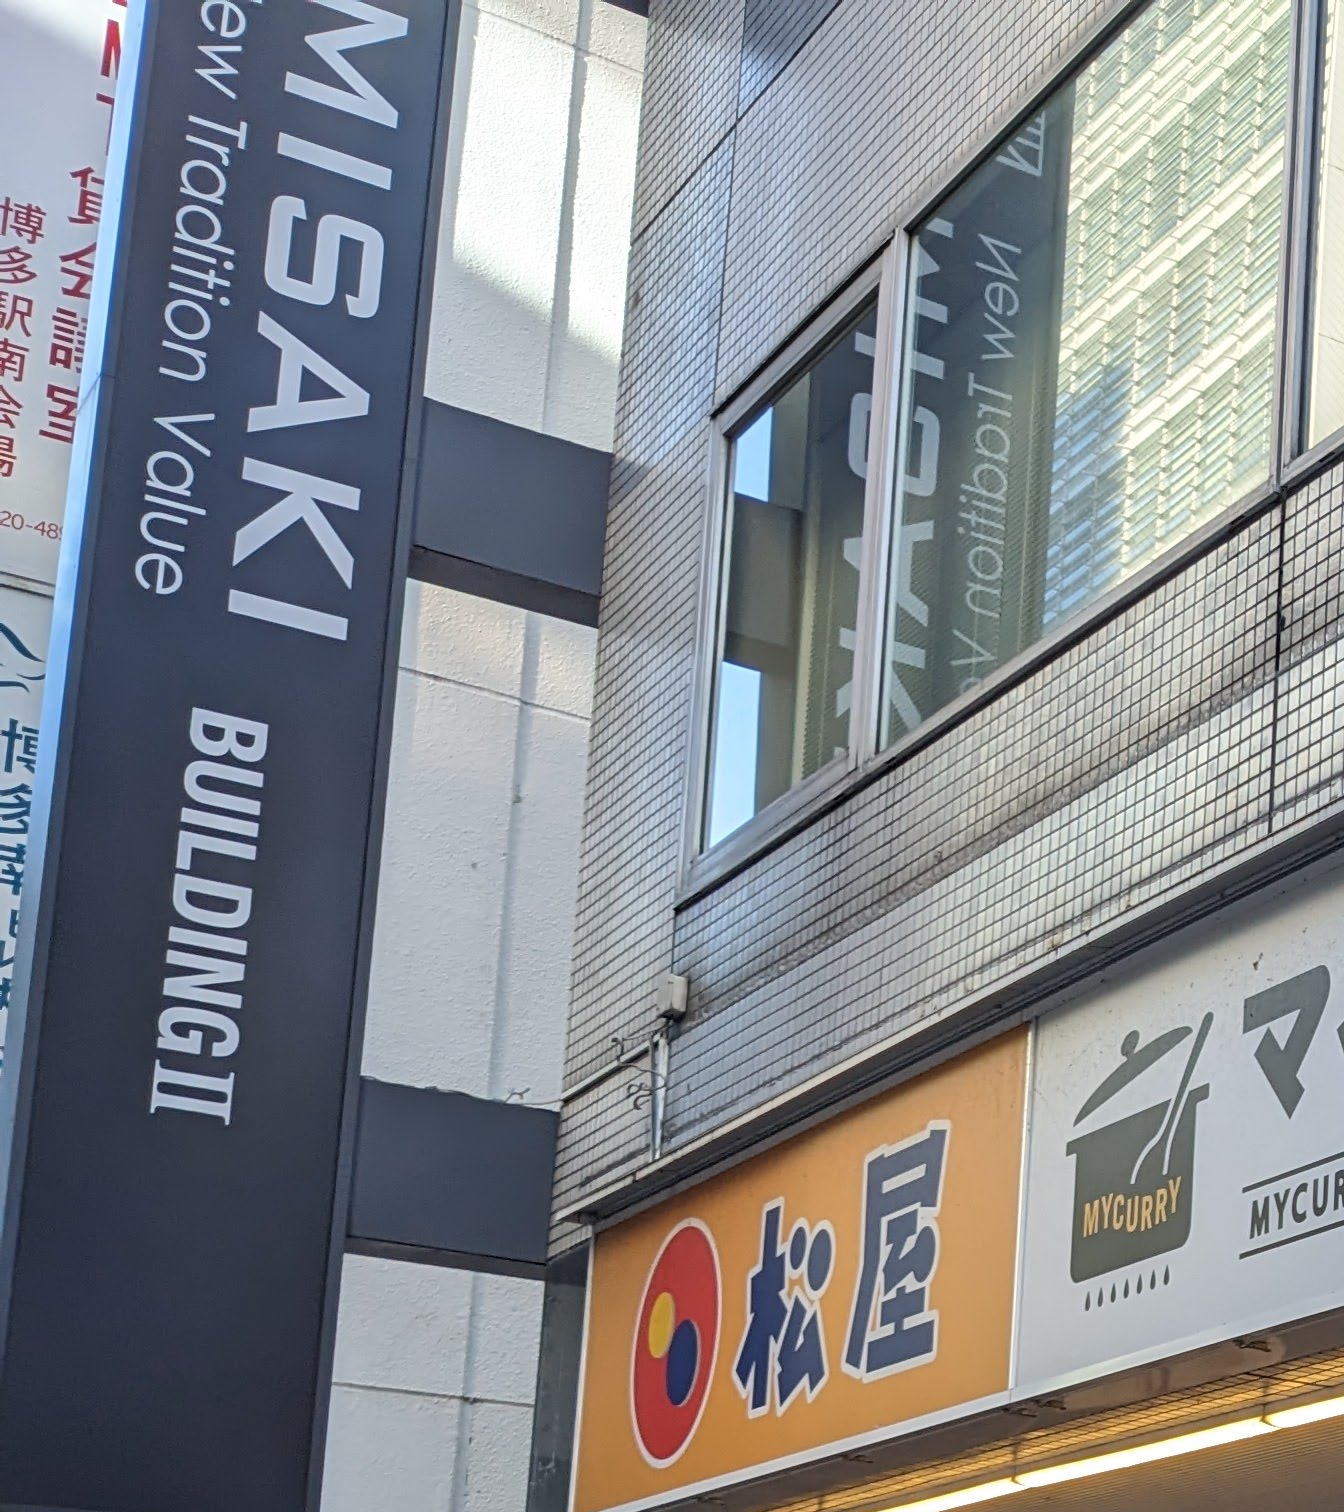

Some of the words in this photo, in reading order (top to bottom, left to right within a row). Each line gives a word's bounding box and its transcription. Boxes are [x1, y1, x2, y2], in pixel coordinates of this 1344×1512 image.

[194, 0, 262, 99] ew
[158, 114, 248, 382] Tradition
[228, 0, 409, 641] MISAKI
[134, 412, 216, 596] Value
[731, 1119, 952, 1419] 松屋
[1082, 1176, 1183, 1240] MYCURRY
